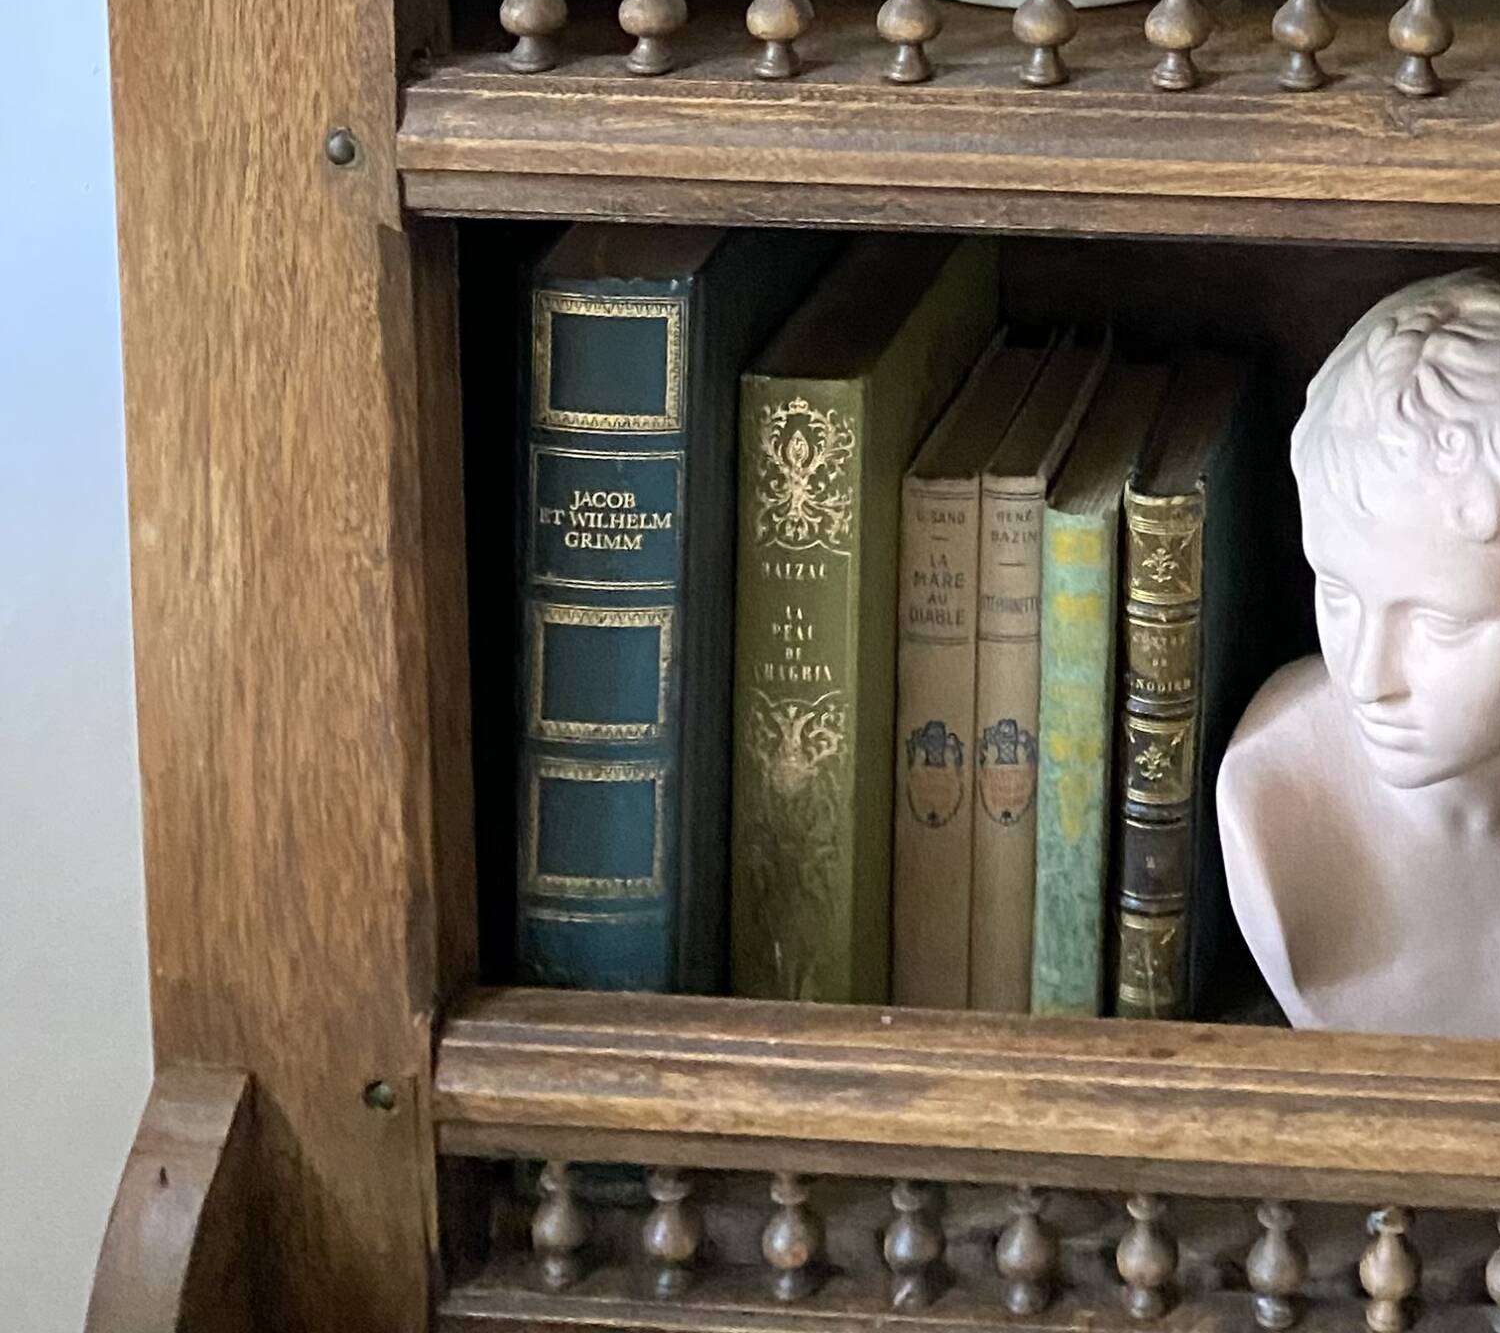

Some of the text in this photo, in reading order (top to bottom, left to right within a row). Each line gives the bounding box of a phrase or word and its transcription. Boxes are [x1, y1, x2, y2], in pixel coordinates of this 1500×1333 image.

[570, 490, 636, 510] JACOB
[539, 507, 672, 529] ET WILHELM
[564, 531, 643, 550] GRIMM
[991, 530, 1039, 544] BAZIN
[929, 553, 949, 569] LA
[913, 570, 966, 590] MARE
[927, 593, 948, 606] AU
[909, 606, 966, 626] DIABLE
